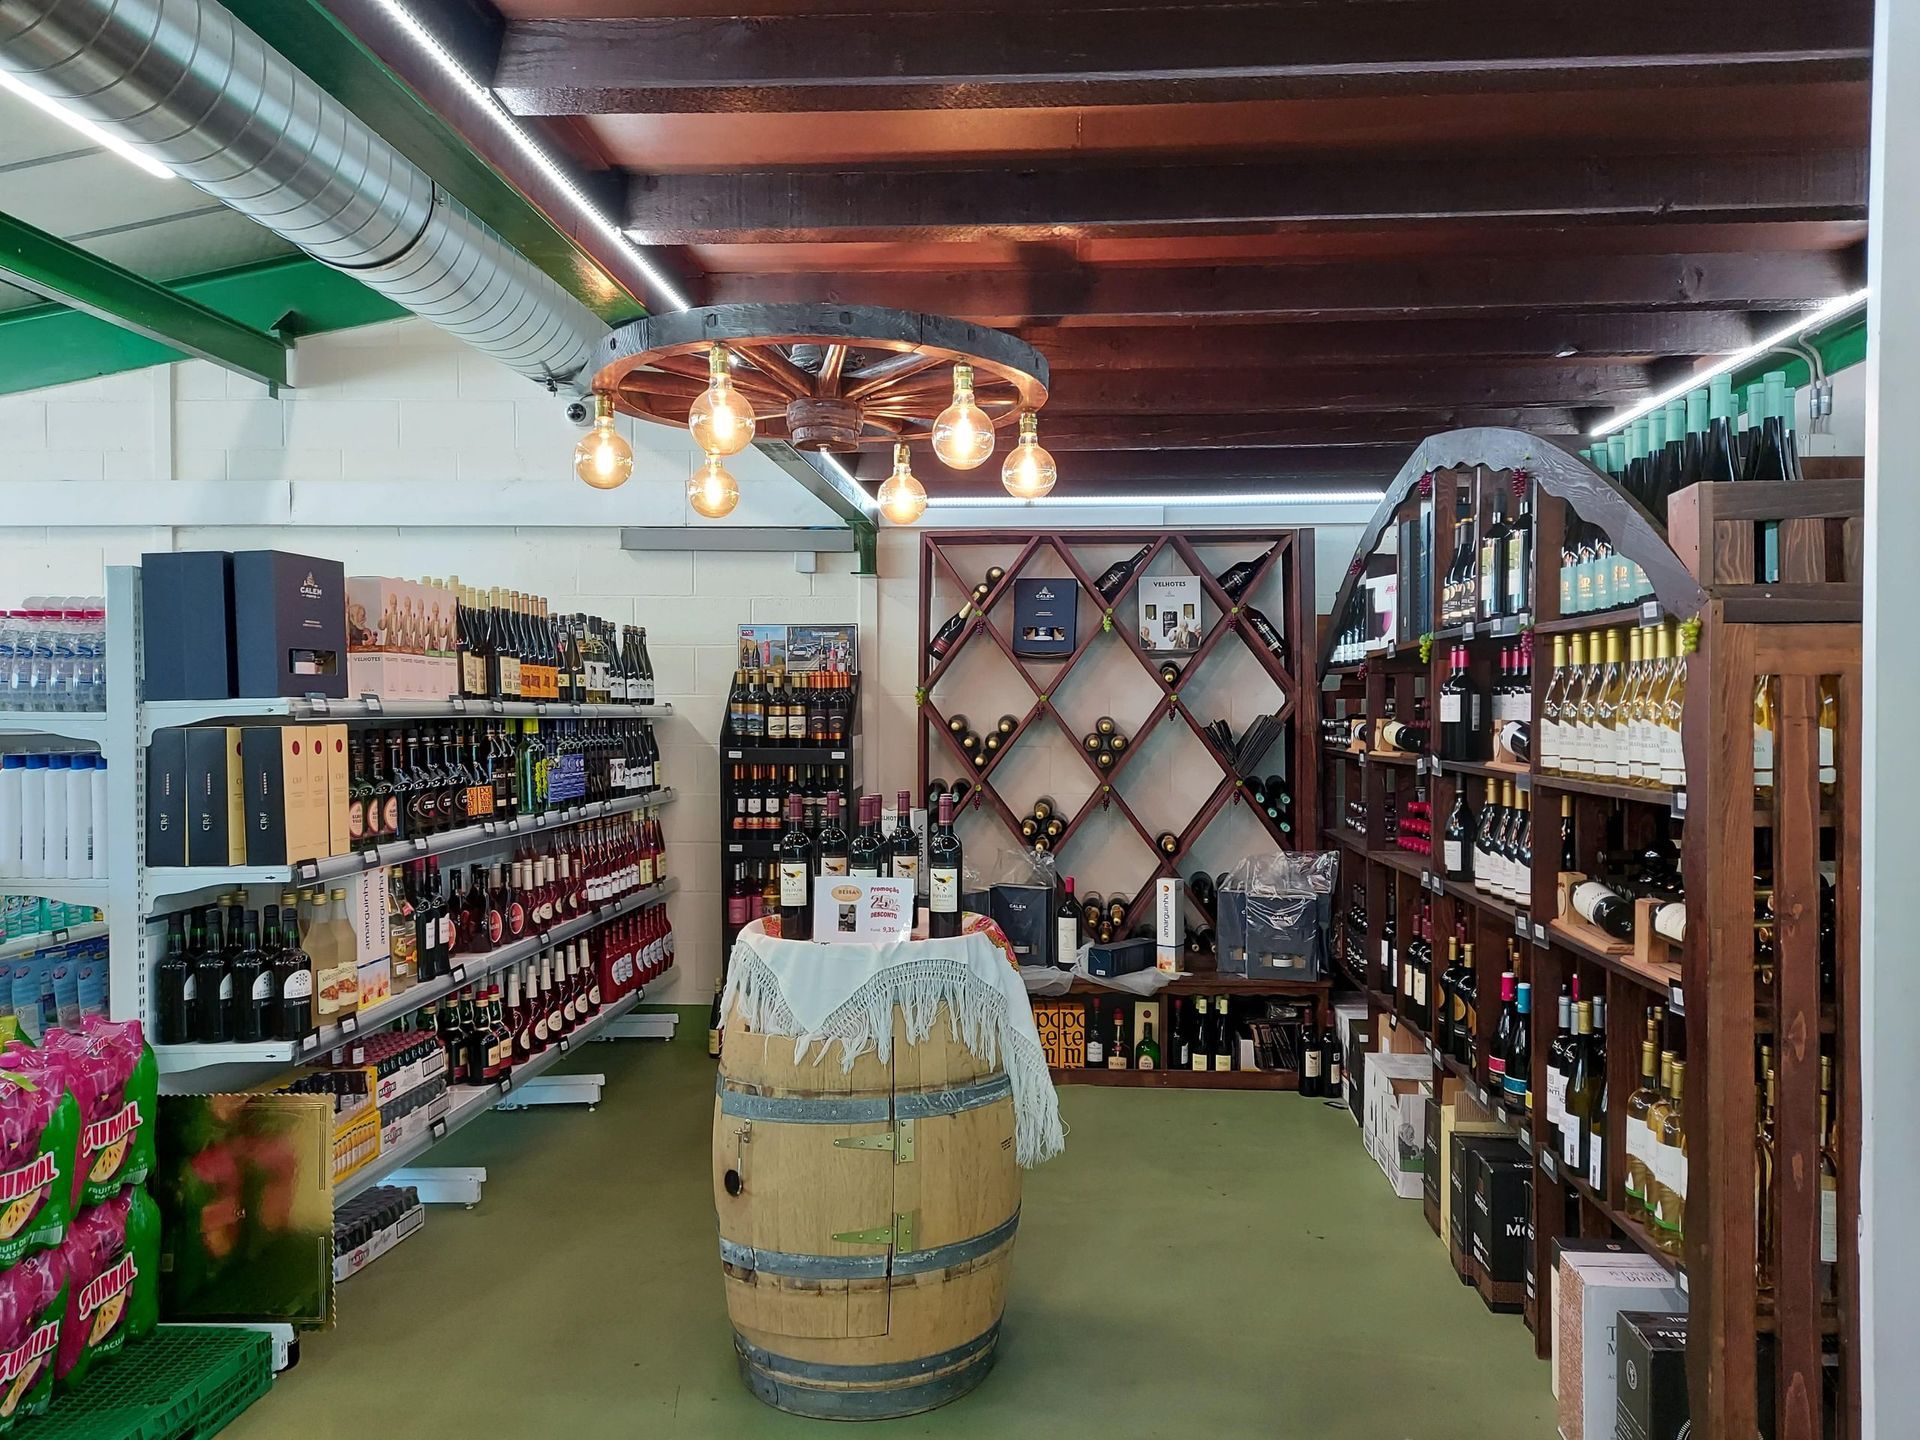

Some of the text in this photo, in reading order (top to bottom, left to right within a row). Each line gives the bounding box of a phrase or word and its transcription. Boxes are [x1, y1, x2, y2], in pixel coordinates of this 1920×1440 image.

[82, 1101, 143, 1158] SUMOL
[0, 1152, 59, 1203] UMOL
[88, 1185, 112, 1195] FRUIT
[79, 1252, 138, 1320] SUMOL
[0, 1320, 60, 1384] SUMOL
